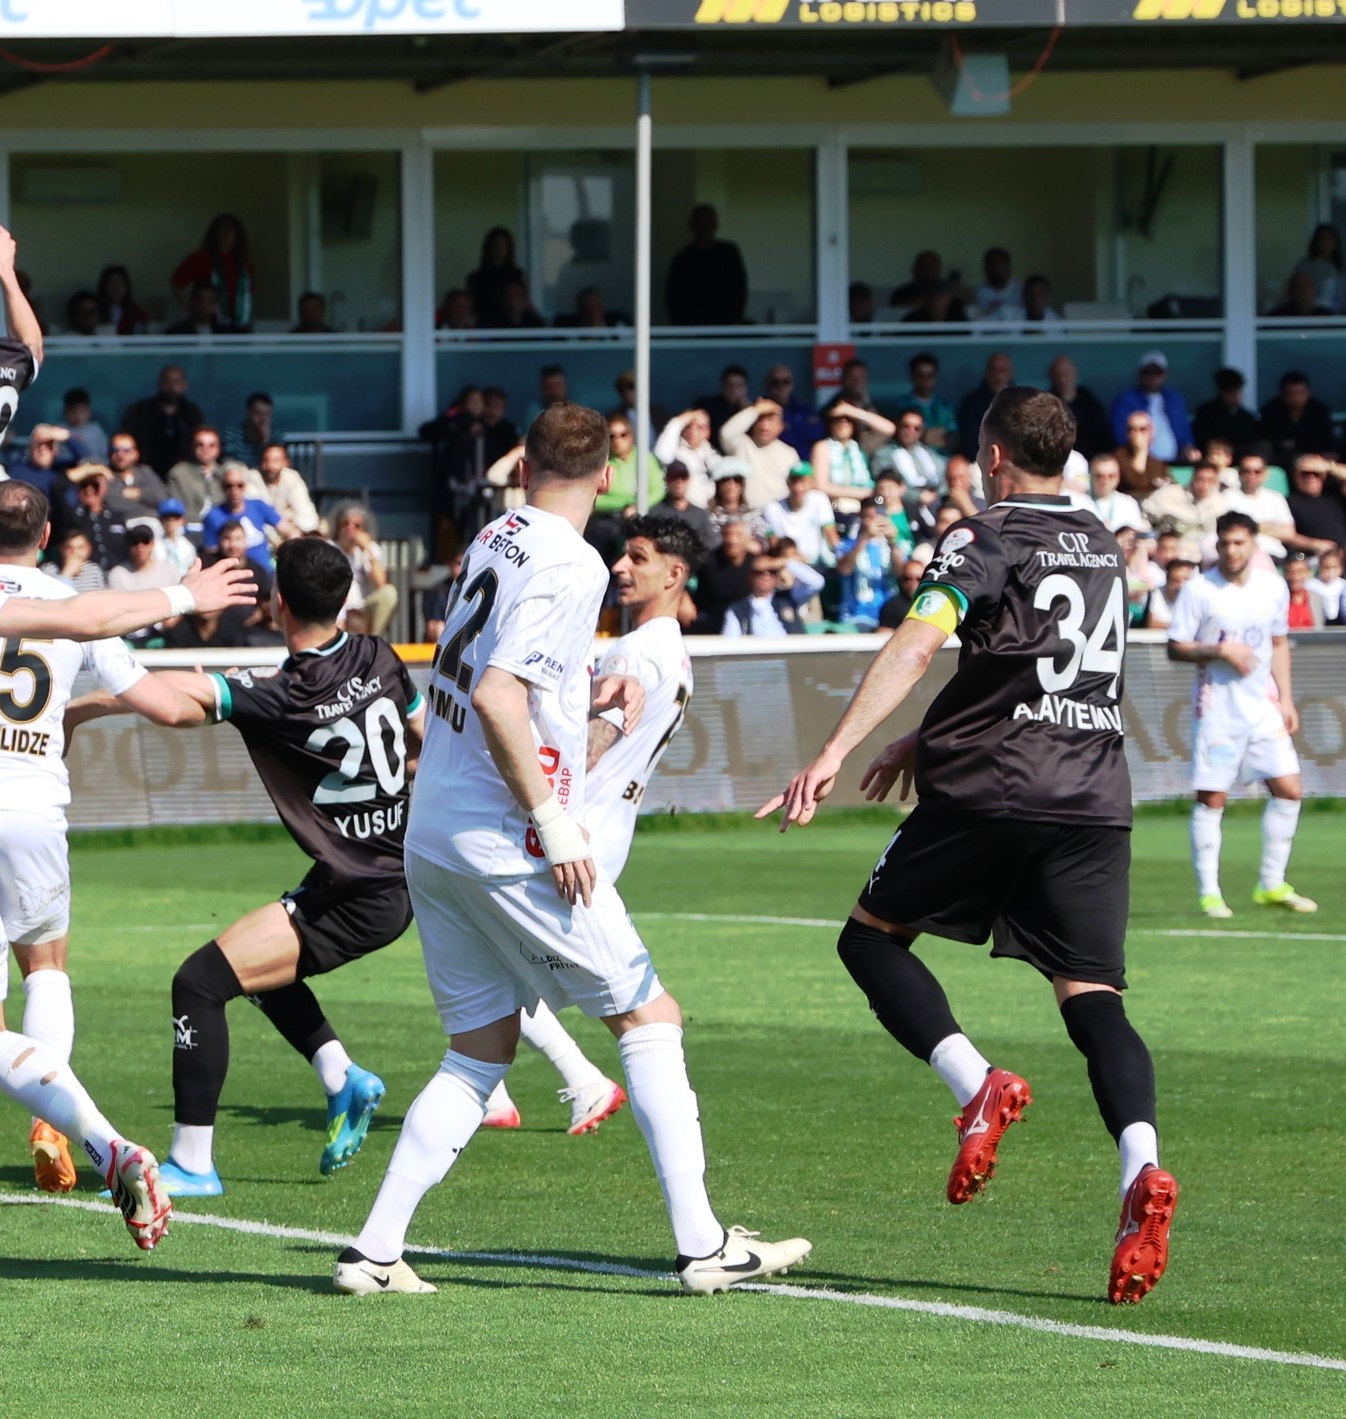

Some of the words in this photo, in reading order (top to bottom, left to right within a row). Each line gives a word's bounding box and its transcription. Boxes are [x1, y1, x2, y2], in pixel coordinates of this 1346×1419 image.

[799, 1, 977, 22] LOGISTICS
[489, 534, 531, 568] BETON
[1036, 551, 1079, 567] TRAVEL
[1079, 553, 1118, 568] AGENCY
[1058, 532, 1089, 553] CIP
[1033, 573, 1125, 699] 34
[1012, 694, 1125, 735] A.AYTEMU
[304, 697, 407, 804] 20
[334, 800, 404, 839] YUSUF
